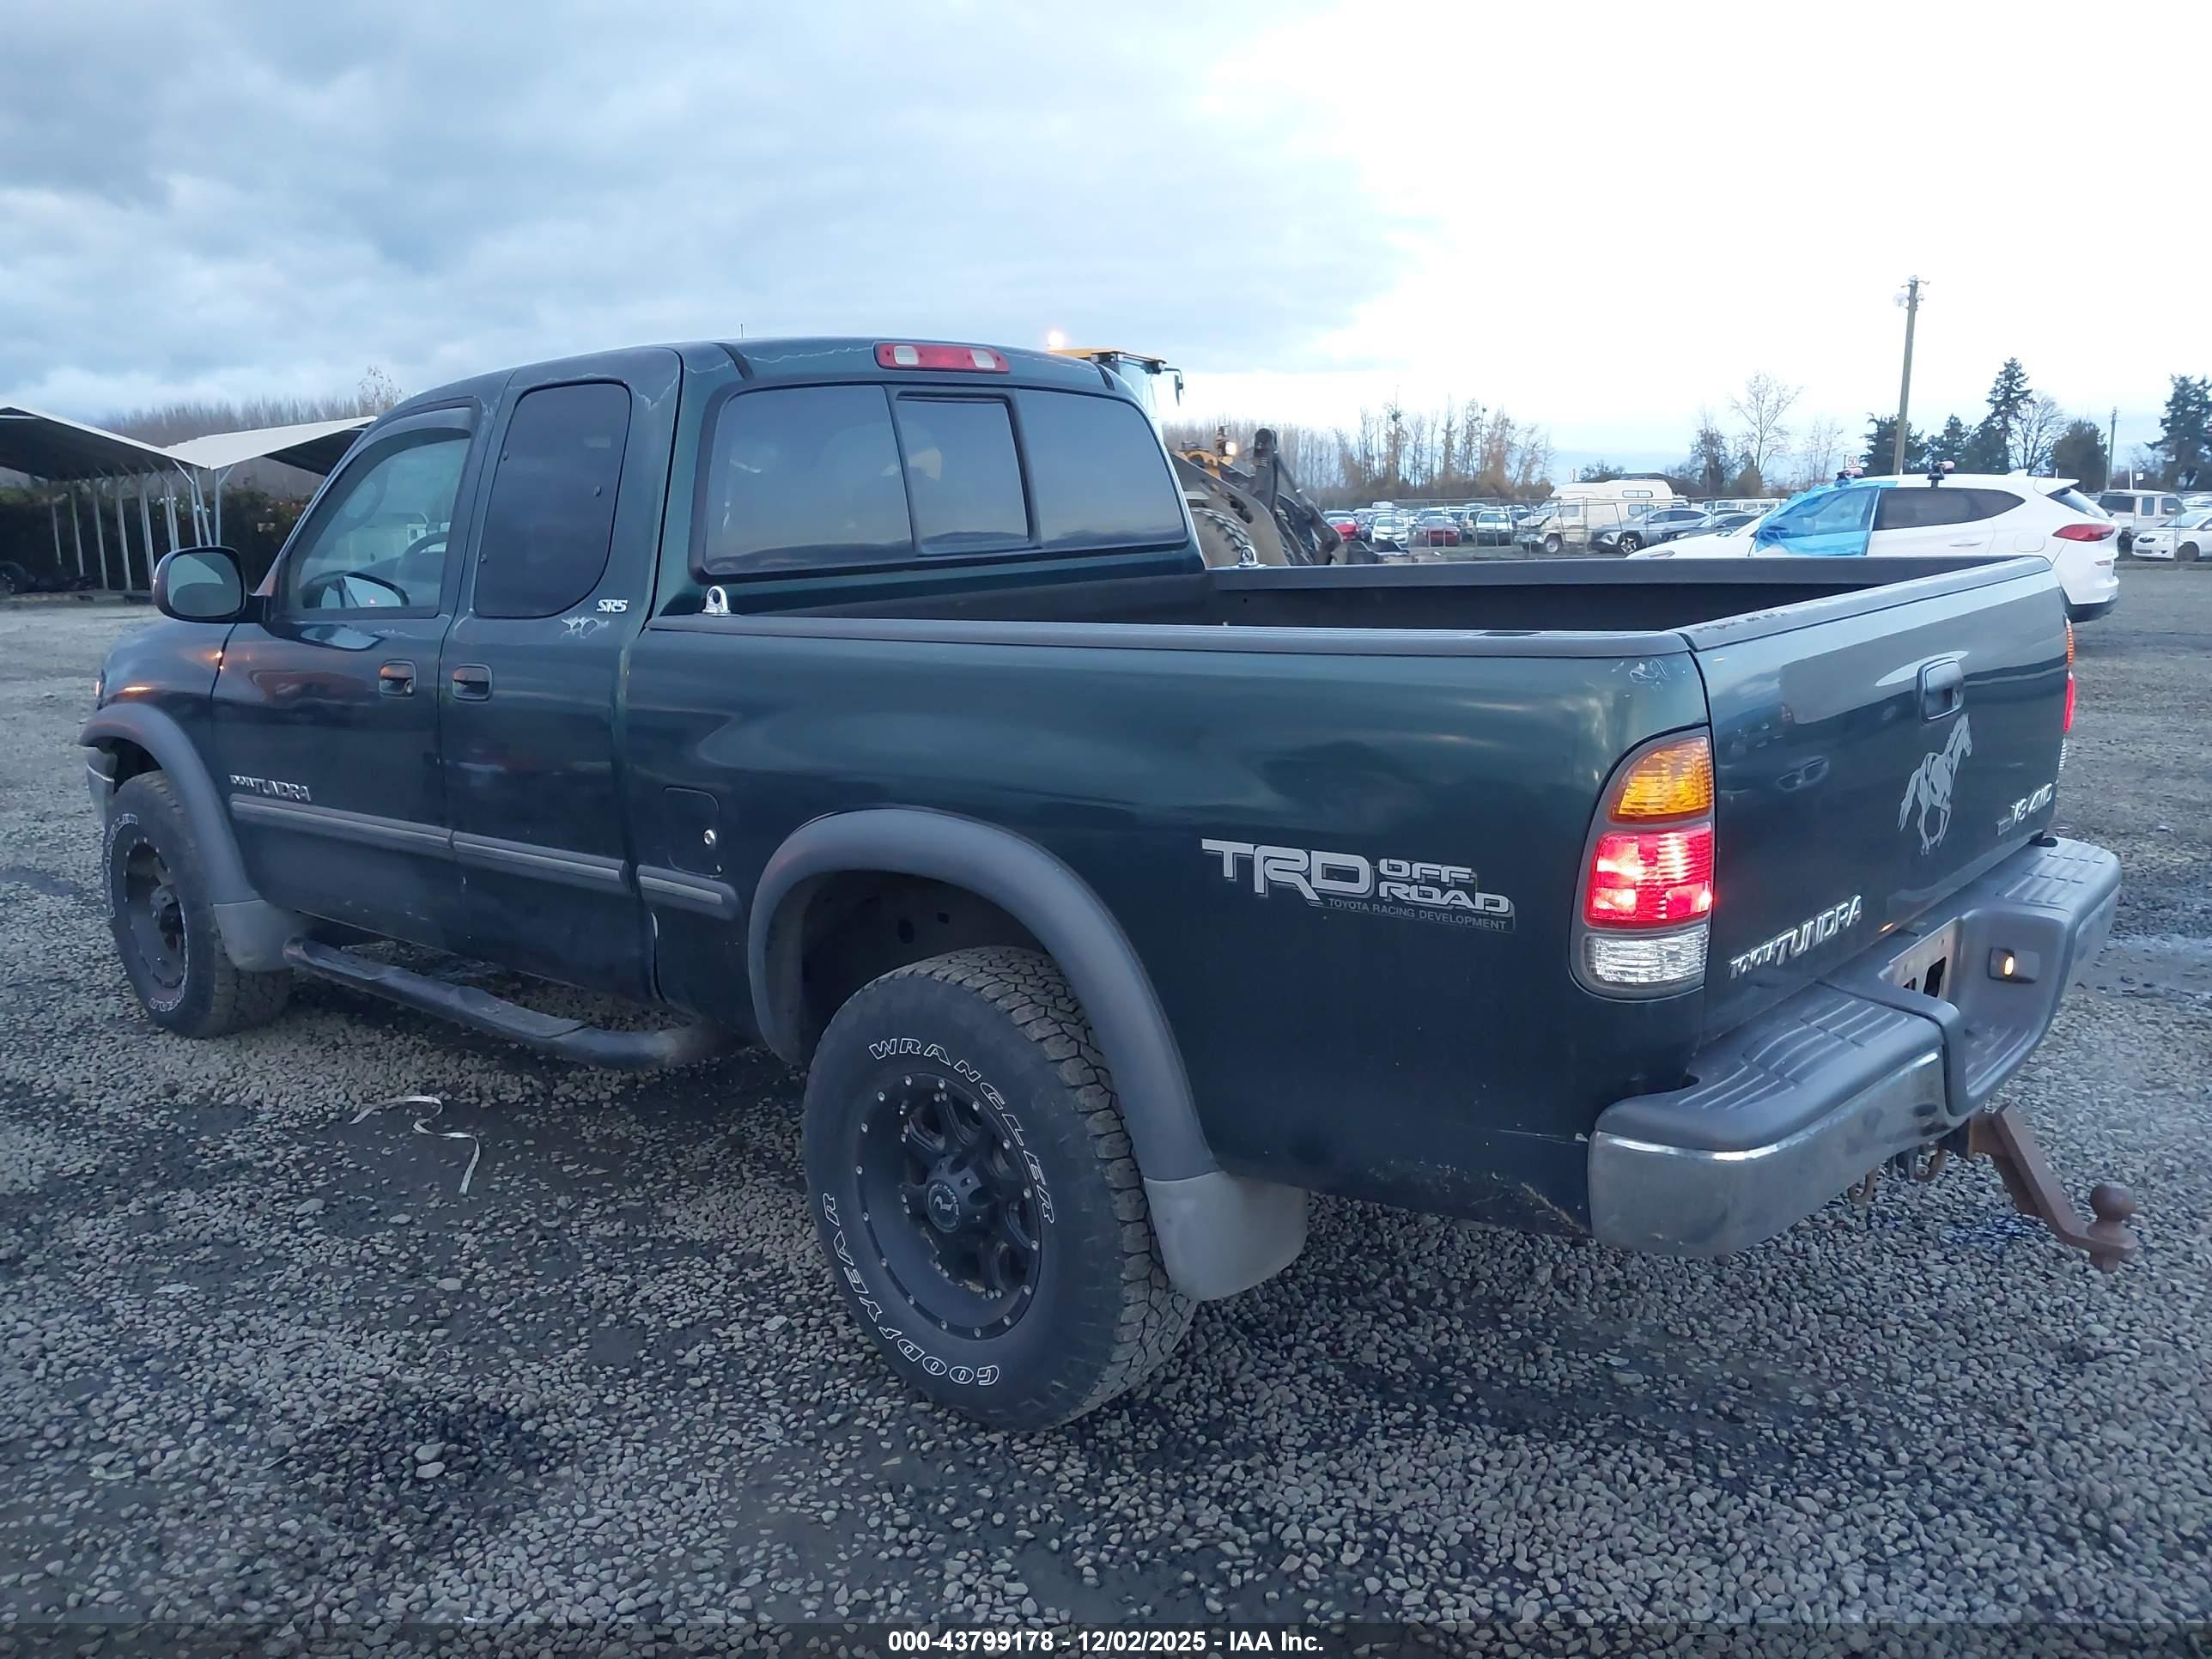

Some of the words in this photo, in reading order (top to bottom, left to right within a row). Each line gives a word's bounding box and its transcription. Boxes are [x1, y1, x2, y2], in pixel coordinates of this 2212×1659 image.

[596, 599, 629, 613] SR5
[1201, 838, 1374, 905] TRD
[1378, 858, 1475, 886] OFF
[1328, 897, 1370, 912] TOYOTA
[1373, 904, 1416, 918] RACING
[1419, 909, 1507, 931] DEVELOPMENT
[1378, 881, 1510, 915] ROAD
[1775, 894, 1863, 966] TUNDRA
[868, 1037, 1055, 1224] WRANGLER
[822, 1192, 1000, 1386] GOODYEAR
